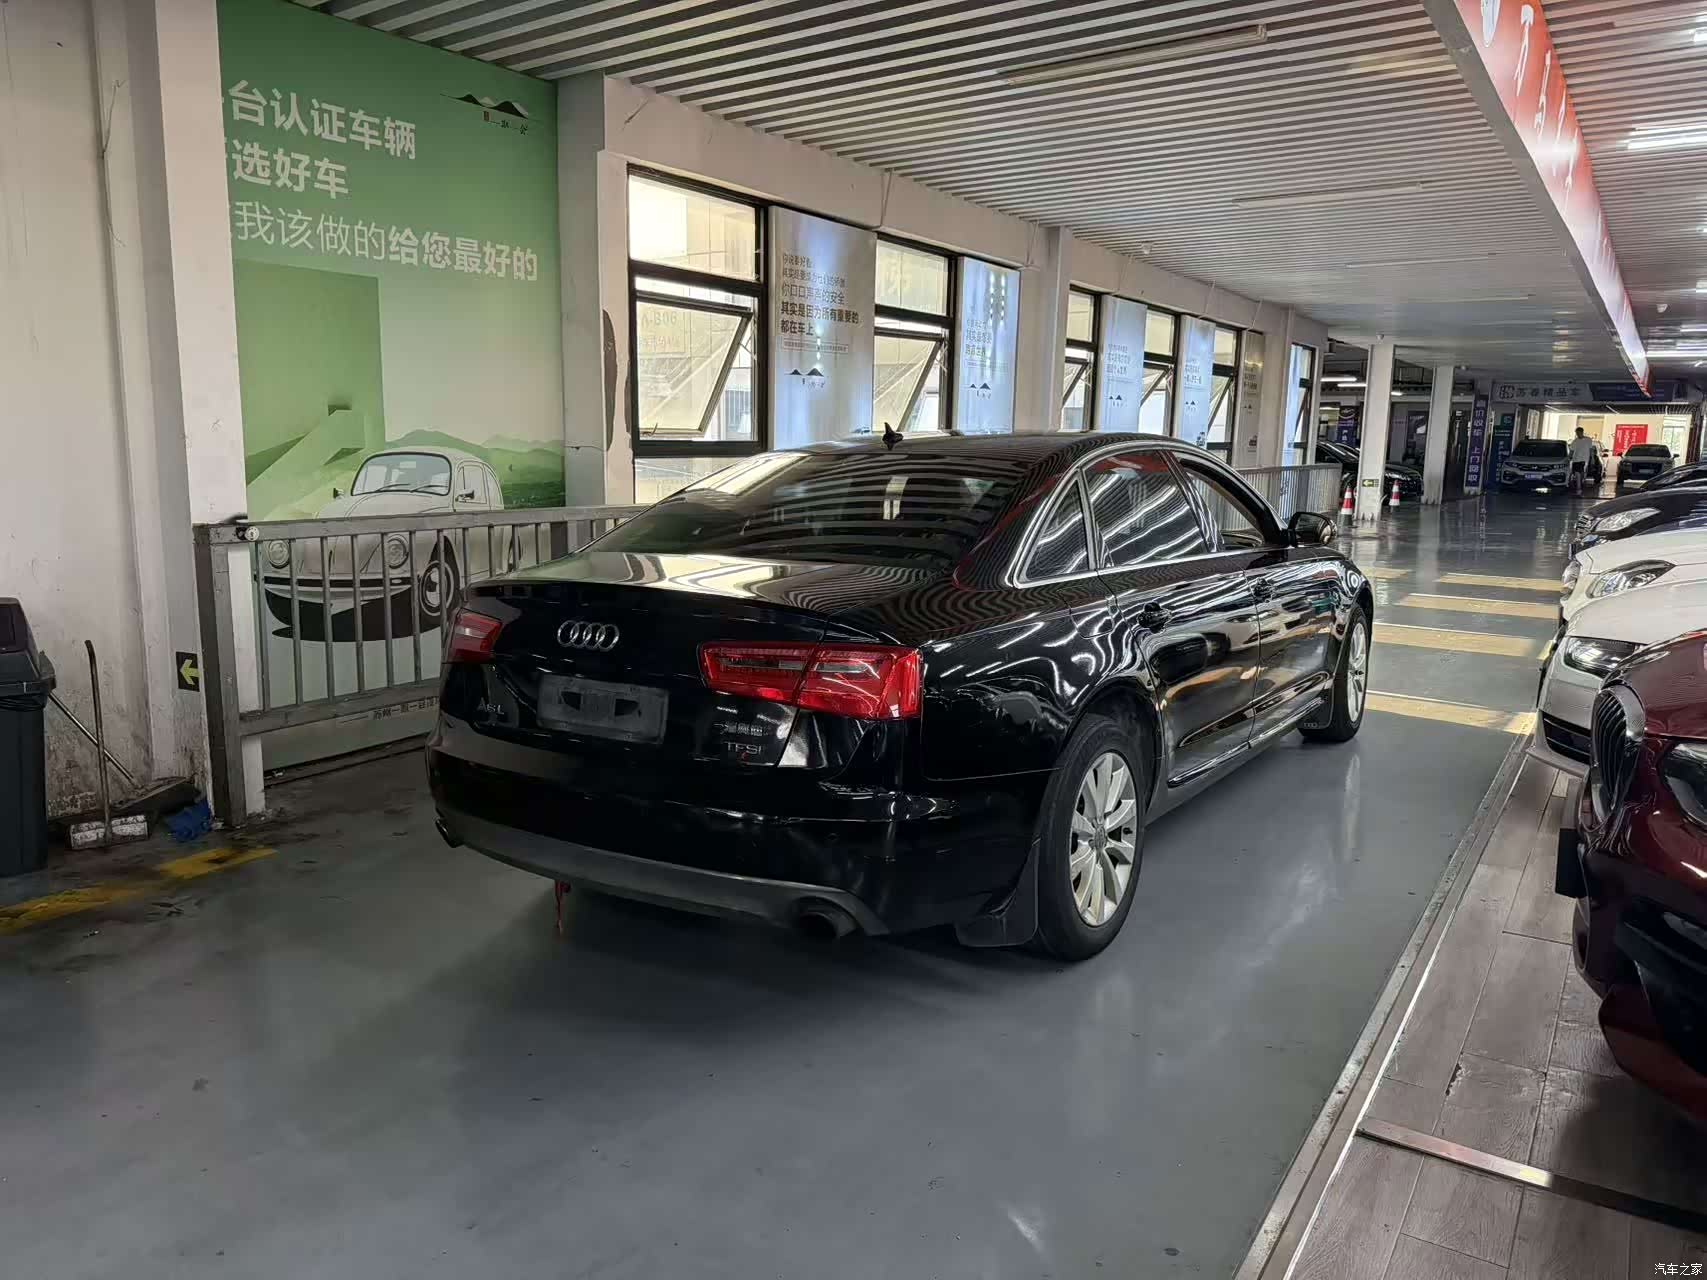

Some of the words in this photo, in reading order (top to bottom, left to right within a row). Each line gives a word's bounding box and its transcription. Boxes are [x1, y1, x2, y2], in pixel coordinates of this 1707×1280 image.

[219, 79, 416, 160] 台认证车辆
[225, 138, 349, 199] 选好车
[235, 200, 538, 281] 我该做的给您最好的
[781, 319, 814, 336] 都在车上
[723, 740, 762, 755] TFSI
